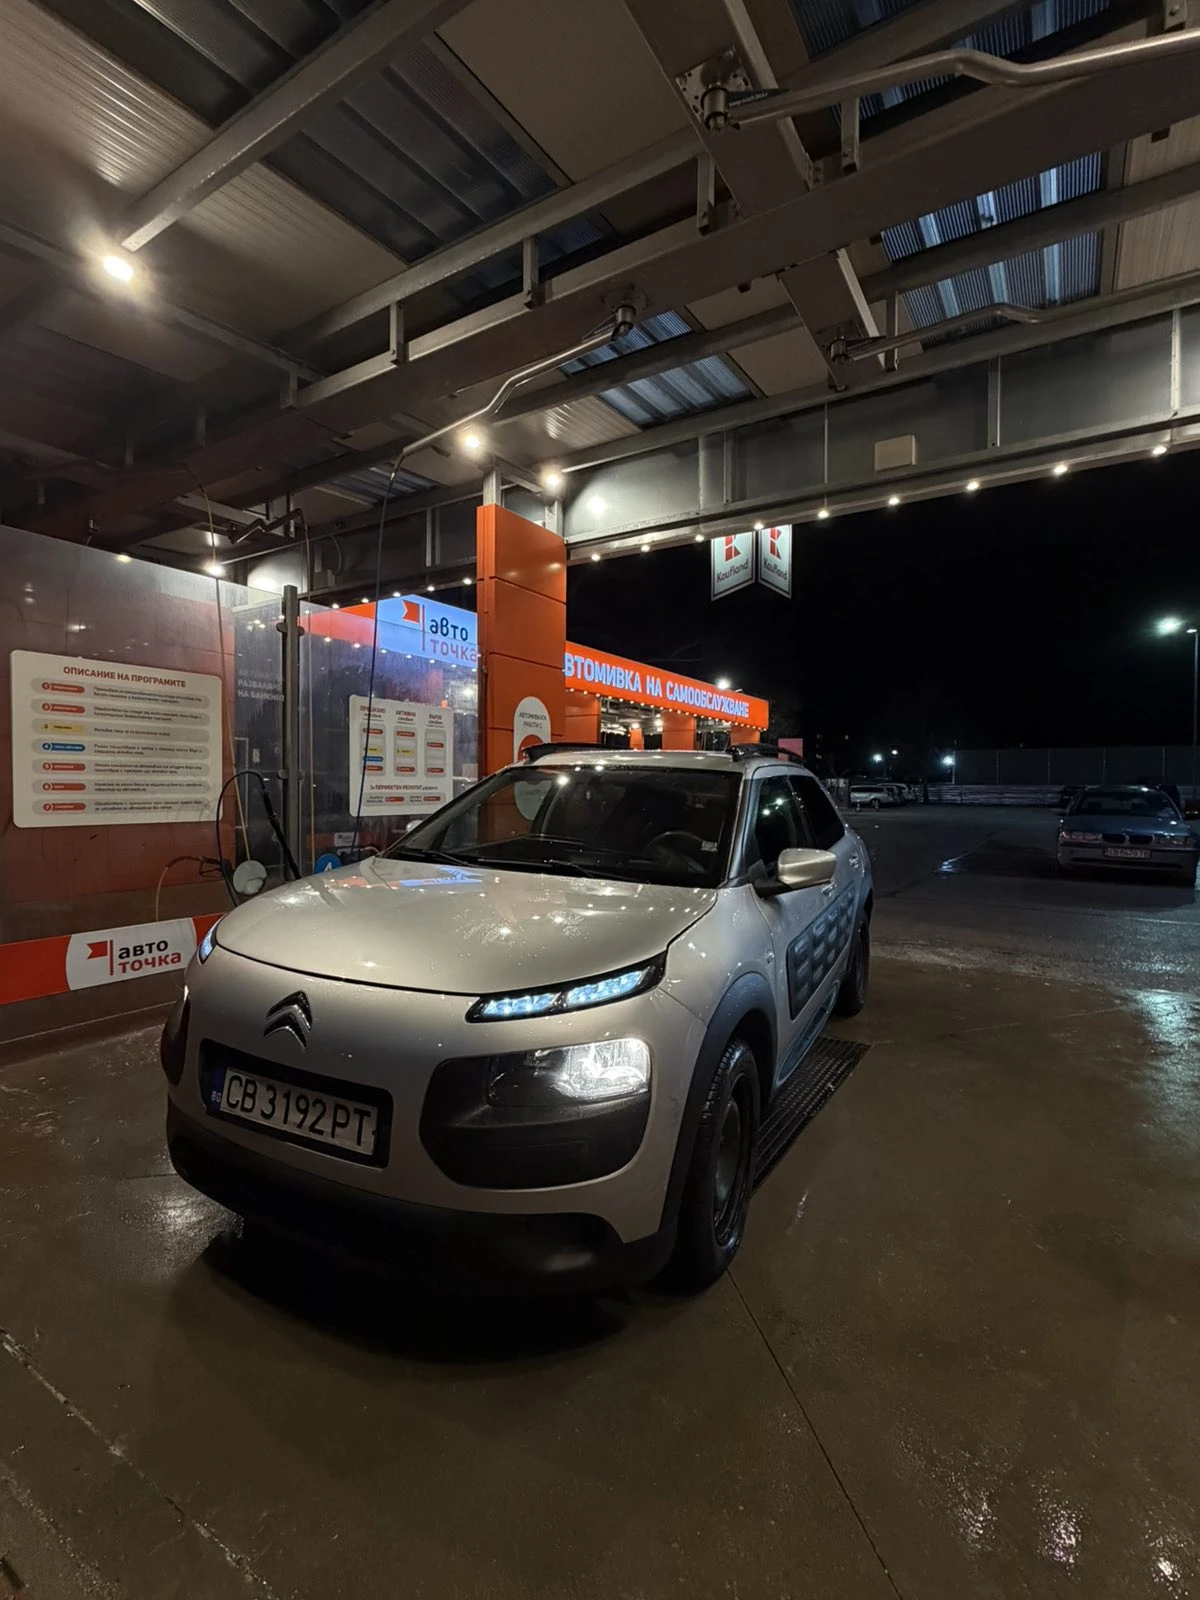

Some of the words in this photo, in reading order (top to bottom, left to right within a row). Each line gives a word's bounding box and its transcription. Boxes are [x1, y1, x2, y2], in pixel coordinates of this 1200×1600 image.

[716, 557, 749, 583] Kaufland
[429, 617, 468, 642] авто
[429, 638, 477, 662] точка
[63, 666, 116, 680] ОПИСАНИЕ
[117, 672, 130, 681] НА
[131, 674, 186, 688] ПРОГРАМИТЕ
[562, 652, 642, 693] ВТОМИВКА
[646, 675, 662, 698] НА
[666, 680, 750, 718] САМООБСЛУЖВАНЕ
[118, 940, 168, 960] авто
[118, 952, 181, 974] точка
